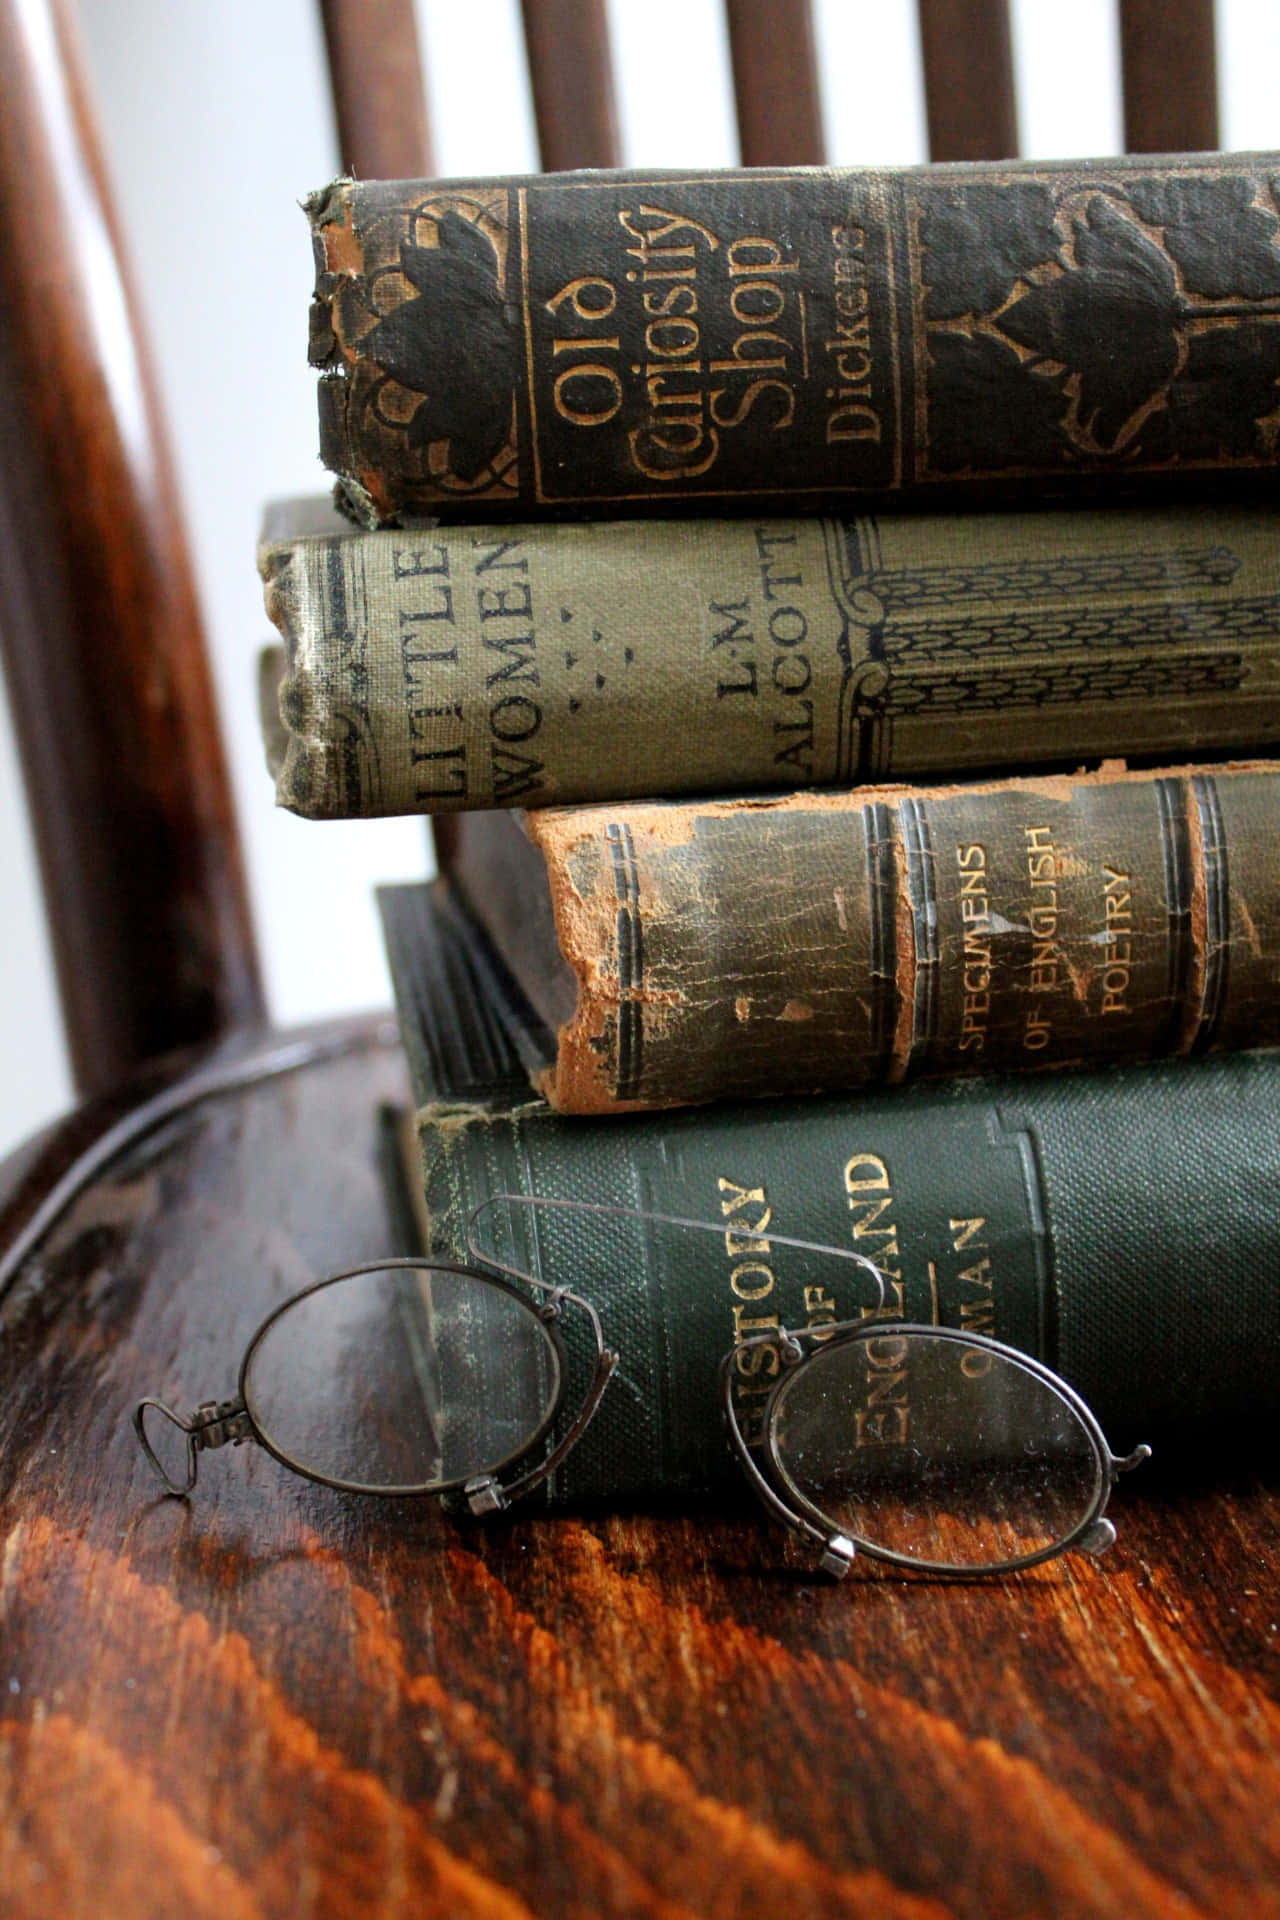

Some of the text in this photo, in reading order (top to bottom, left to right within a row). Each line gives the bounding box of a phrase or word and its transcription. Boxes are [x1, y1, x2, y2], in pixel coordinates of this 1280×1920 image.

[545, 275, 623, 427] Old
[618, 203, 720, 481] Curiosity
[709, 235, 801, 430] Shop
[392, 544, 467, 802] LITTLE
[472, 538, 545, 801] WOMEN
[753, 526, 815, 775] ALCOTT
[956, 842, 992, 1051] SPECIMENS
[1023, 824, 1058, 1051] OF ENGLISH
[1101, 863, 1132, 1016] POETRY
[803, 1285, 838, 1341] OF
[844, 1152, 912, 1449] ENGLAND
[949, 1216, 995, 1379] OMAN
